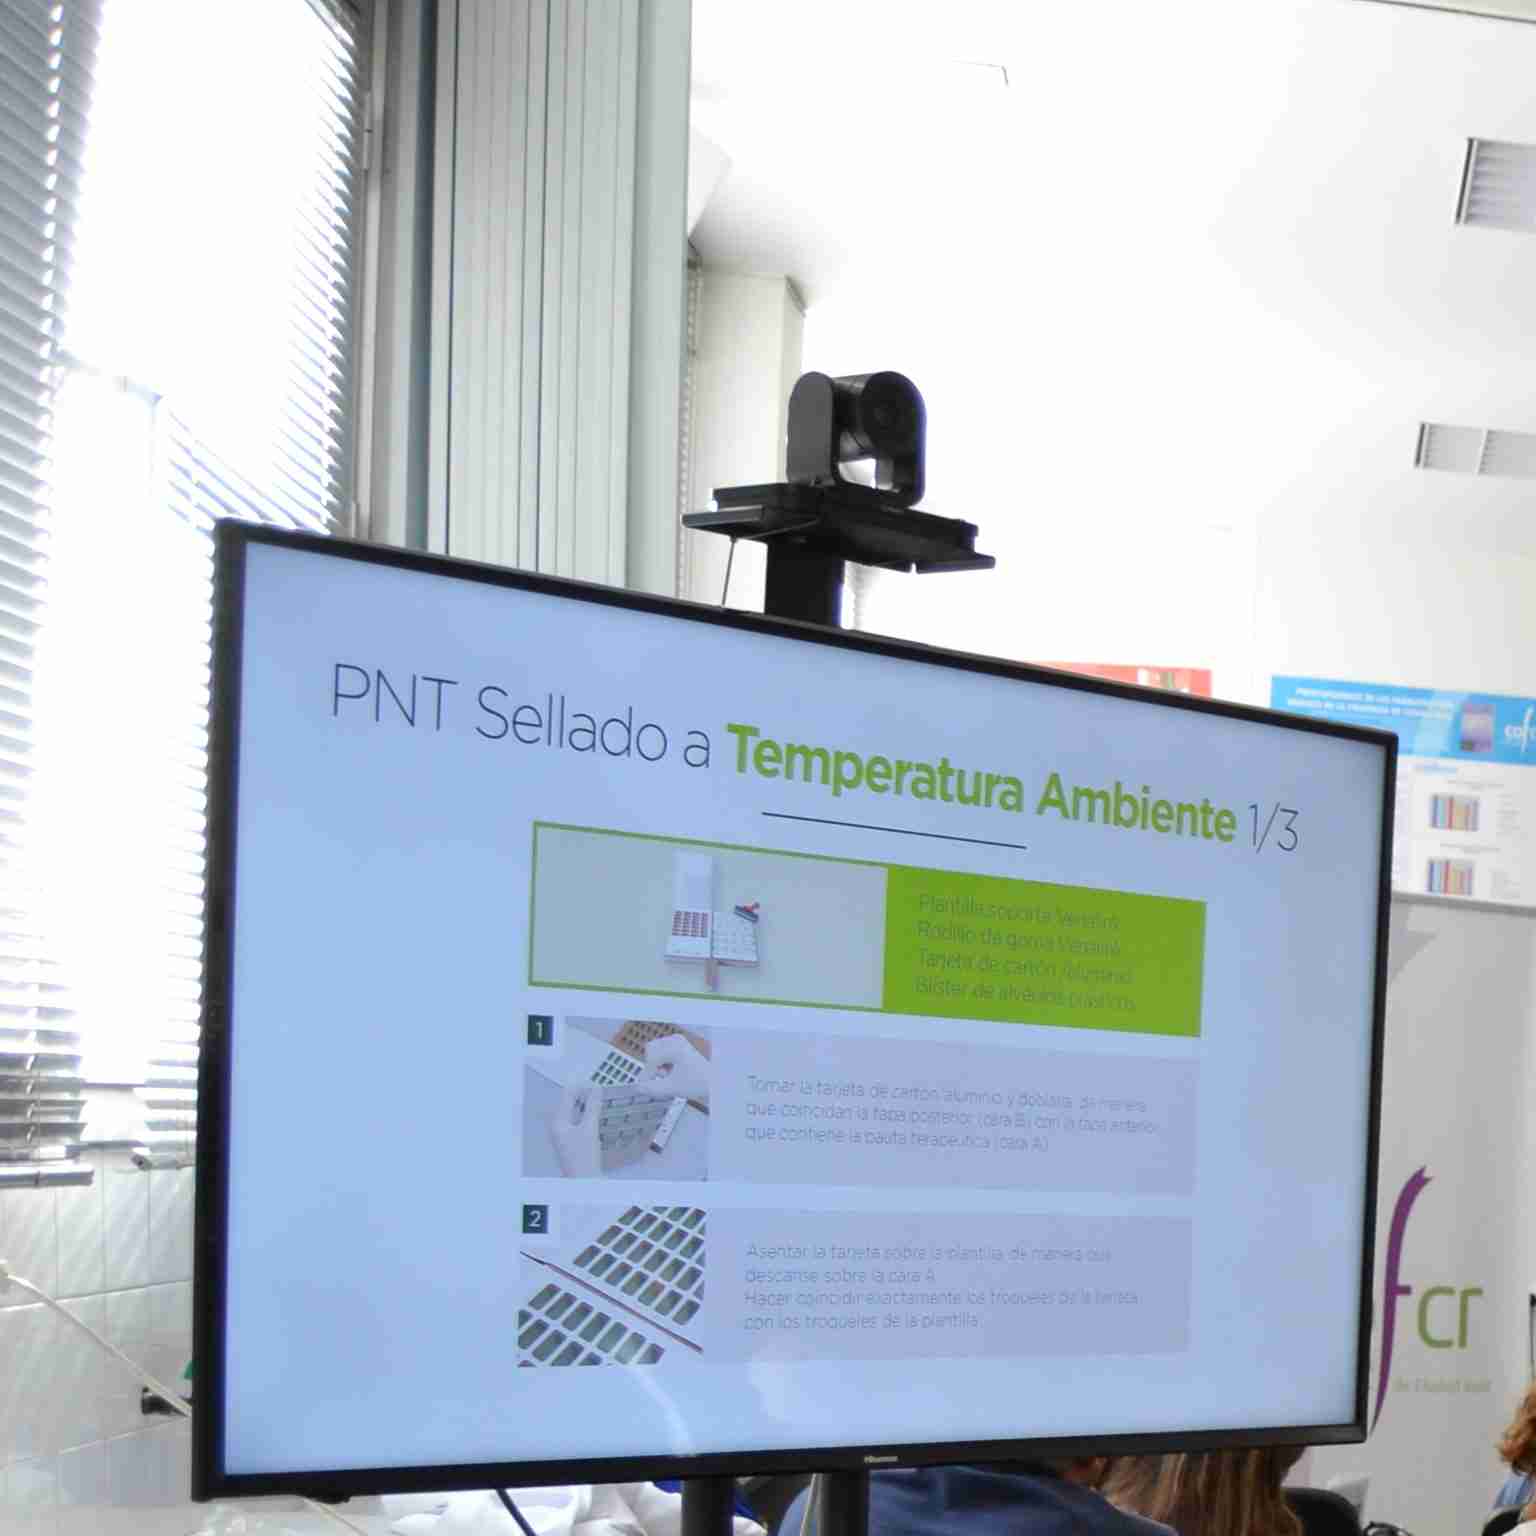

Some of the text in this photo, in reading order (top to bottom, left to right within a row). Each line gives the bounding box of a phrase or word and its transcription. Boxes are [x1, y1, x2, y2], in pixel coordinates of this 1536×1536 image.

[333, 663, 1301, 854] PNT Sellado a Temperatura Ambiente 1/3
[535, 1021, 543, 1040] 1
[529, 1210, 541, 1228] 2
[745, 1242, 808, 1259] Asentar
[744, 1267, 819, 1283] descanse
